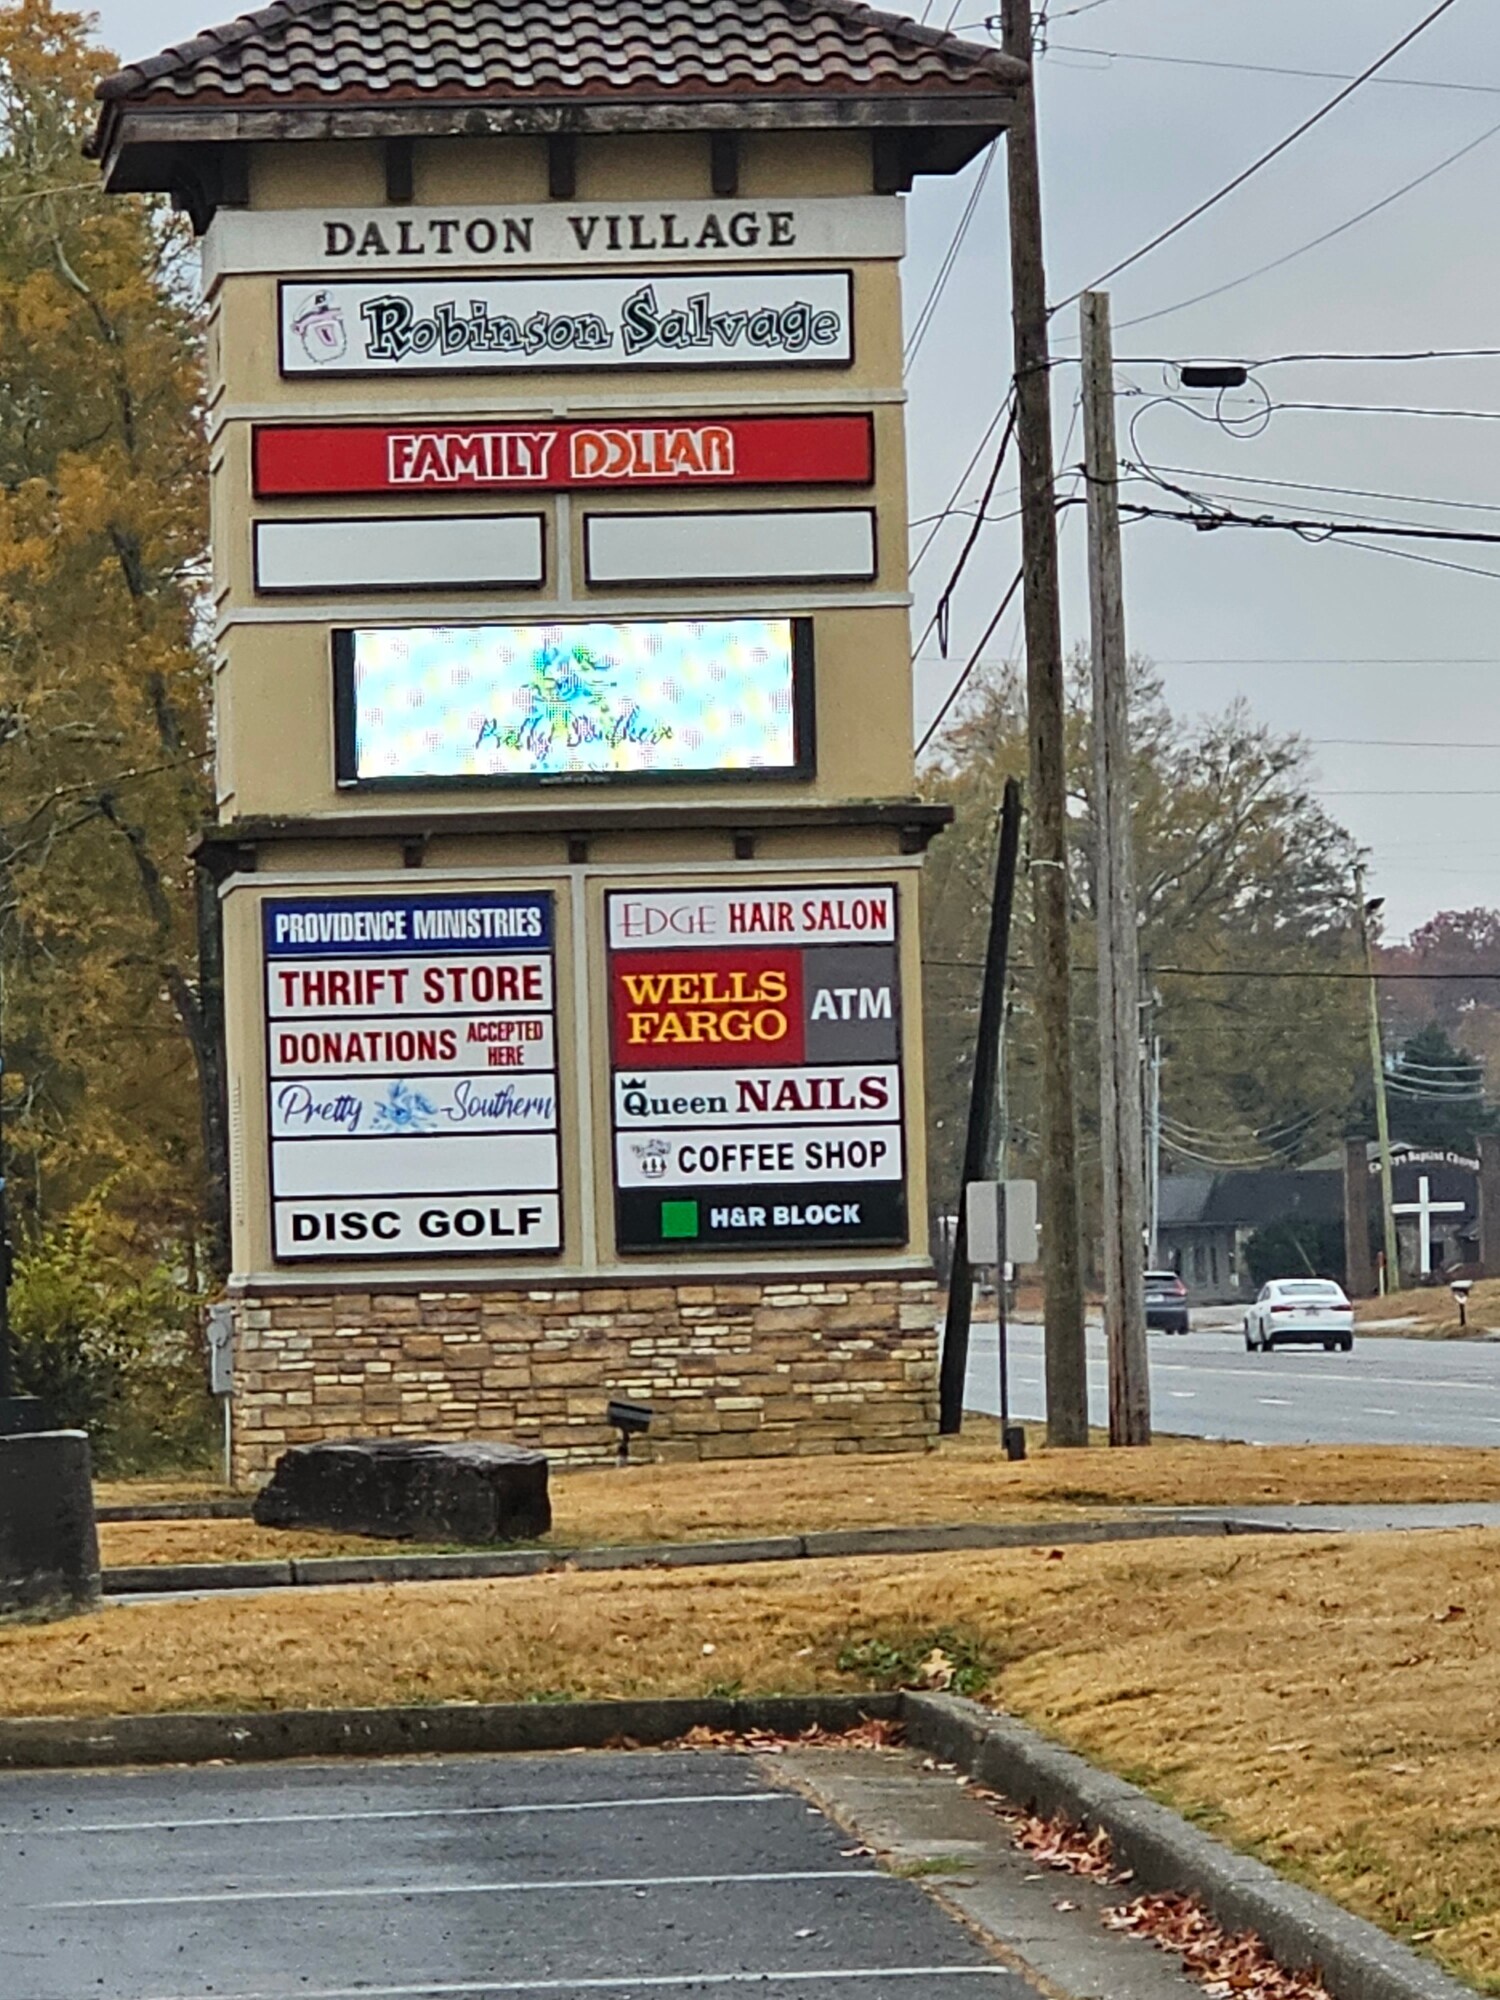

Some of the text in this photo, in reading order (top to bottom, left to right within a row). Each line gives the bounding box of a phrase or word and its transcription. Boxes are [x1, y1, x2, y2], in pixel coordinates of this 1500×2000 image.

[324, 212, 797, 256] DALTON VILLAGE
[361, 284, 839, 361] Robinson Salvage
[388, 427, 735, 483] FAMILY DOLLAR
[275, 907, 543, 943] PROVIDENCE MINISTRIES
[618, 899, 888, 938] EDGE HAIR SALON
[278, 965, 543, 1007] THRIFT STORE
[621, 971, 788, 1005] WELLS
[810, 987, 893, 1020] ATM
[466, 1020, 544, 1043] ACCEPTED
[627, 1008, 788, 1044] FARGO
[279, 1030, 458, 1065] DONATIONS
[487, 1045, 525, 1067] HERE
[277, 1080, 554, 1132] Pretty Southern
[623, 1076, 889, 1117] Queen NAILS
[677, 1140, 887, 1174] COFFEE SHOP
[292, 1207, 543, 1242] DISC GOLF
[710, 1203, 861, 1229] H&R BLOCK
